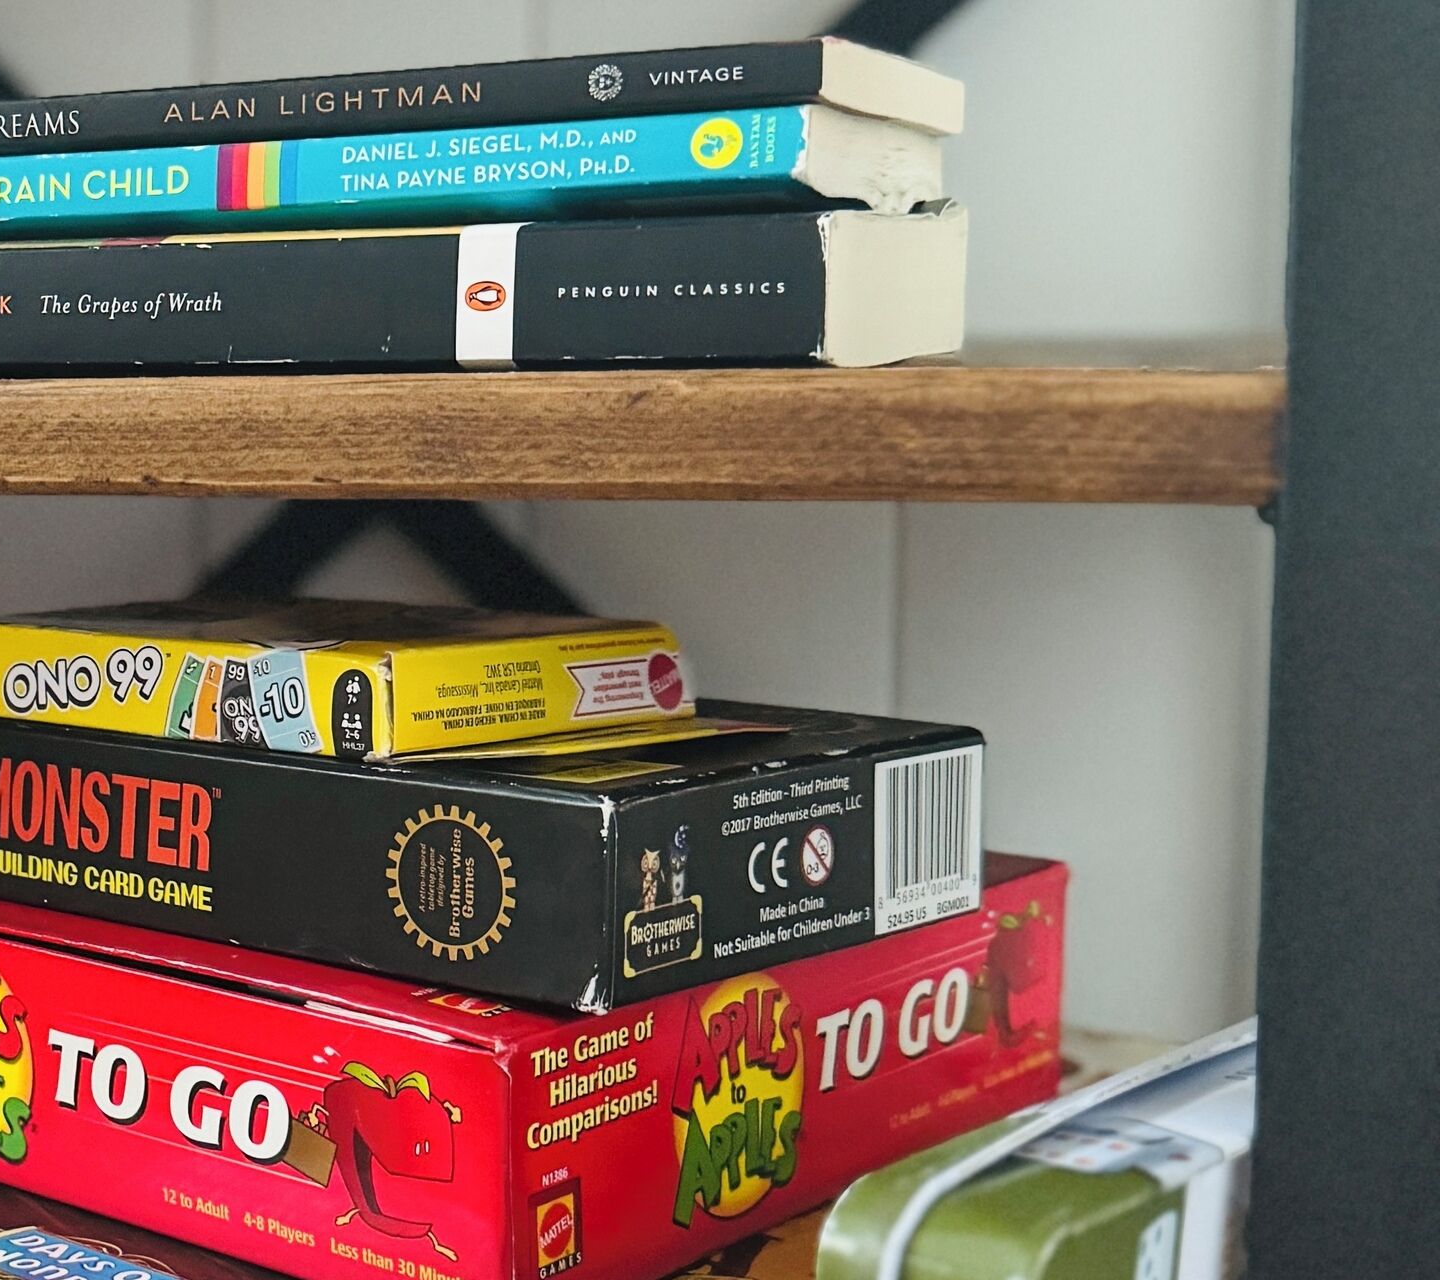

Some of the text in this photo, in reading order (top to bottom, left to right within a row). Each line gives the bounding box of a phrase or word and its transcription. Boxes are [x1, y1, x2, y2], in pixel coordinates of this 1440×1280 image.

[648, 65, 745, 88] VINTAGE
[163, 82, 483, 123] ALAN LIGHTMAN
[342, 128, 637, 164] DANIEL J. SIEGEL, M.D., AND
[749, 113, 762, 169] BANTAM
[764, 115, 777, 163] BOOKS
[82, 165, 190, 201] CHILD
[340, 172, 393, 192] TINA
[397, 165, 467, 189] PAYNE
[472, 159, 572, 186] BRYSON,
[40, 295, 71, 315] The
[77, 294, 139, 321] Grapes
[144, 292, 164, 321] of
[168, 291, 223, 313] Wrath
[557, 281, 786, 299] PENGUIN CLASSICS
[4, 645, 163, 714] ONO 99
[228, 664, 245, 681] 99
[254, 659, 270, 676] -10
[516, 660, 541, 675] Ontario
[522, 677, 543, 692] Mattel
[650, 670, 677, 693] MATTEL
[260, 677, 305, 723] -10
[494, 680, 521, 694] Canada
[445, 704, 482, 718] FABRICADO
[345, 729, 360, 739] 2-6
[733, 775, 850, 809] 5th Edition Third Printing
[754, 808, 808, 830] Brotherwise
[810, 800, 844, 819] Games,
[846, 795, 862, 810] LLC
[449, 829, 462, 937] Brotherwise
[748, 837, 789, 893] CE
[84, 866, 145, 899] CARD
[147, 878, 213, 913] GAME
[428, 872, 436, 911] tabletop
[437, 864, 446, 907] designed
[463, 857, 474, 918] Games
[760, 896, 824, 922] Made in China
[916, 906, 927, 920] US
[631, 915, 696, 945] BROTHERWISE
[647, 938, 681, 958] GAMES
[714, 907, 870, 958] Not Suitable for Children Under 3
[531, 1012, 655, 1077] The Game of
[816, 999, 884, 1093] TO
[899, 967, 970, 1058] GO
[673, 986, 801, 1117] APPLES
[48, 1028, 290, 1164] TO GO
[548, 1058, 637, 1108] Hilarious
[731, 1082, 746, 1105] to
[527, 1079, 658, 1151] Comparisons!
[673, 1096, 801, 1230] APPLES
[162, 1187, 178, 1204] 12
[180, 1194, 192, 1210] to
[196, 1196, 230, 1221] Adult
[244, 1211, 265, 1232] 4-8
[268, 1218, 315, 1248] Players
[330, 1236, 358, 1260] Less
[362, 1247, 394, 1271] than
[398, 1259, 416, 1277] 30
[539, 1213, 573, 1249] MATTEL
[8, 1232, 113, 1273] DAYS
[539, 1251, 582, 1280] GAMES
